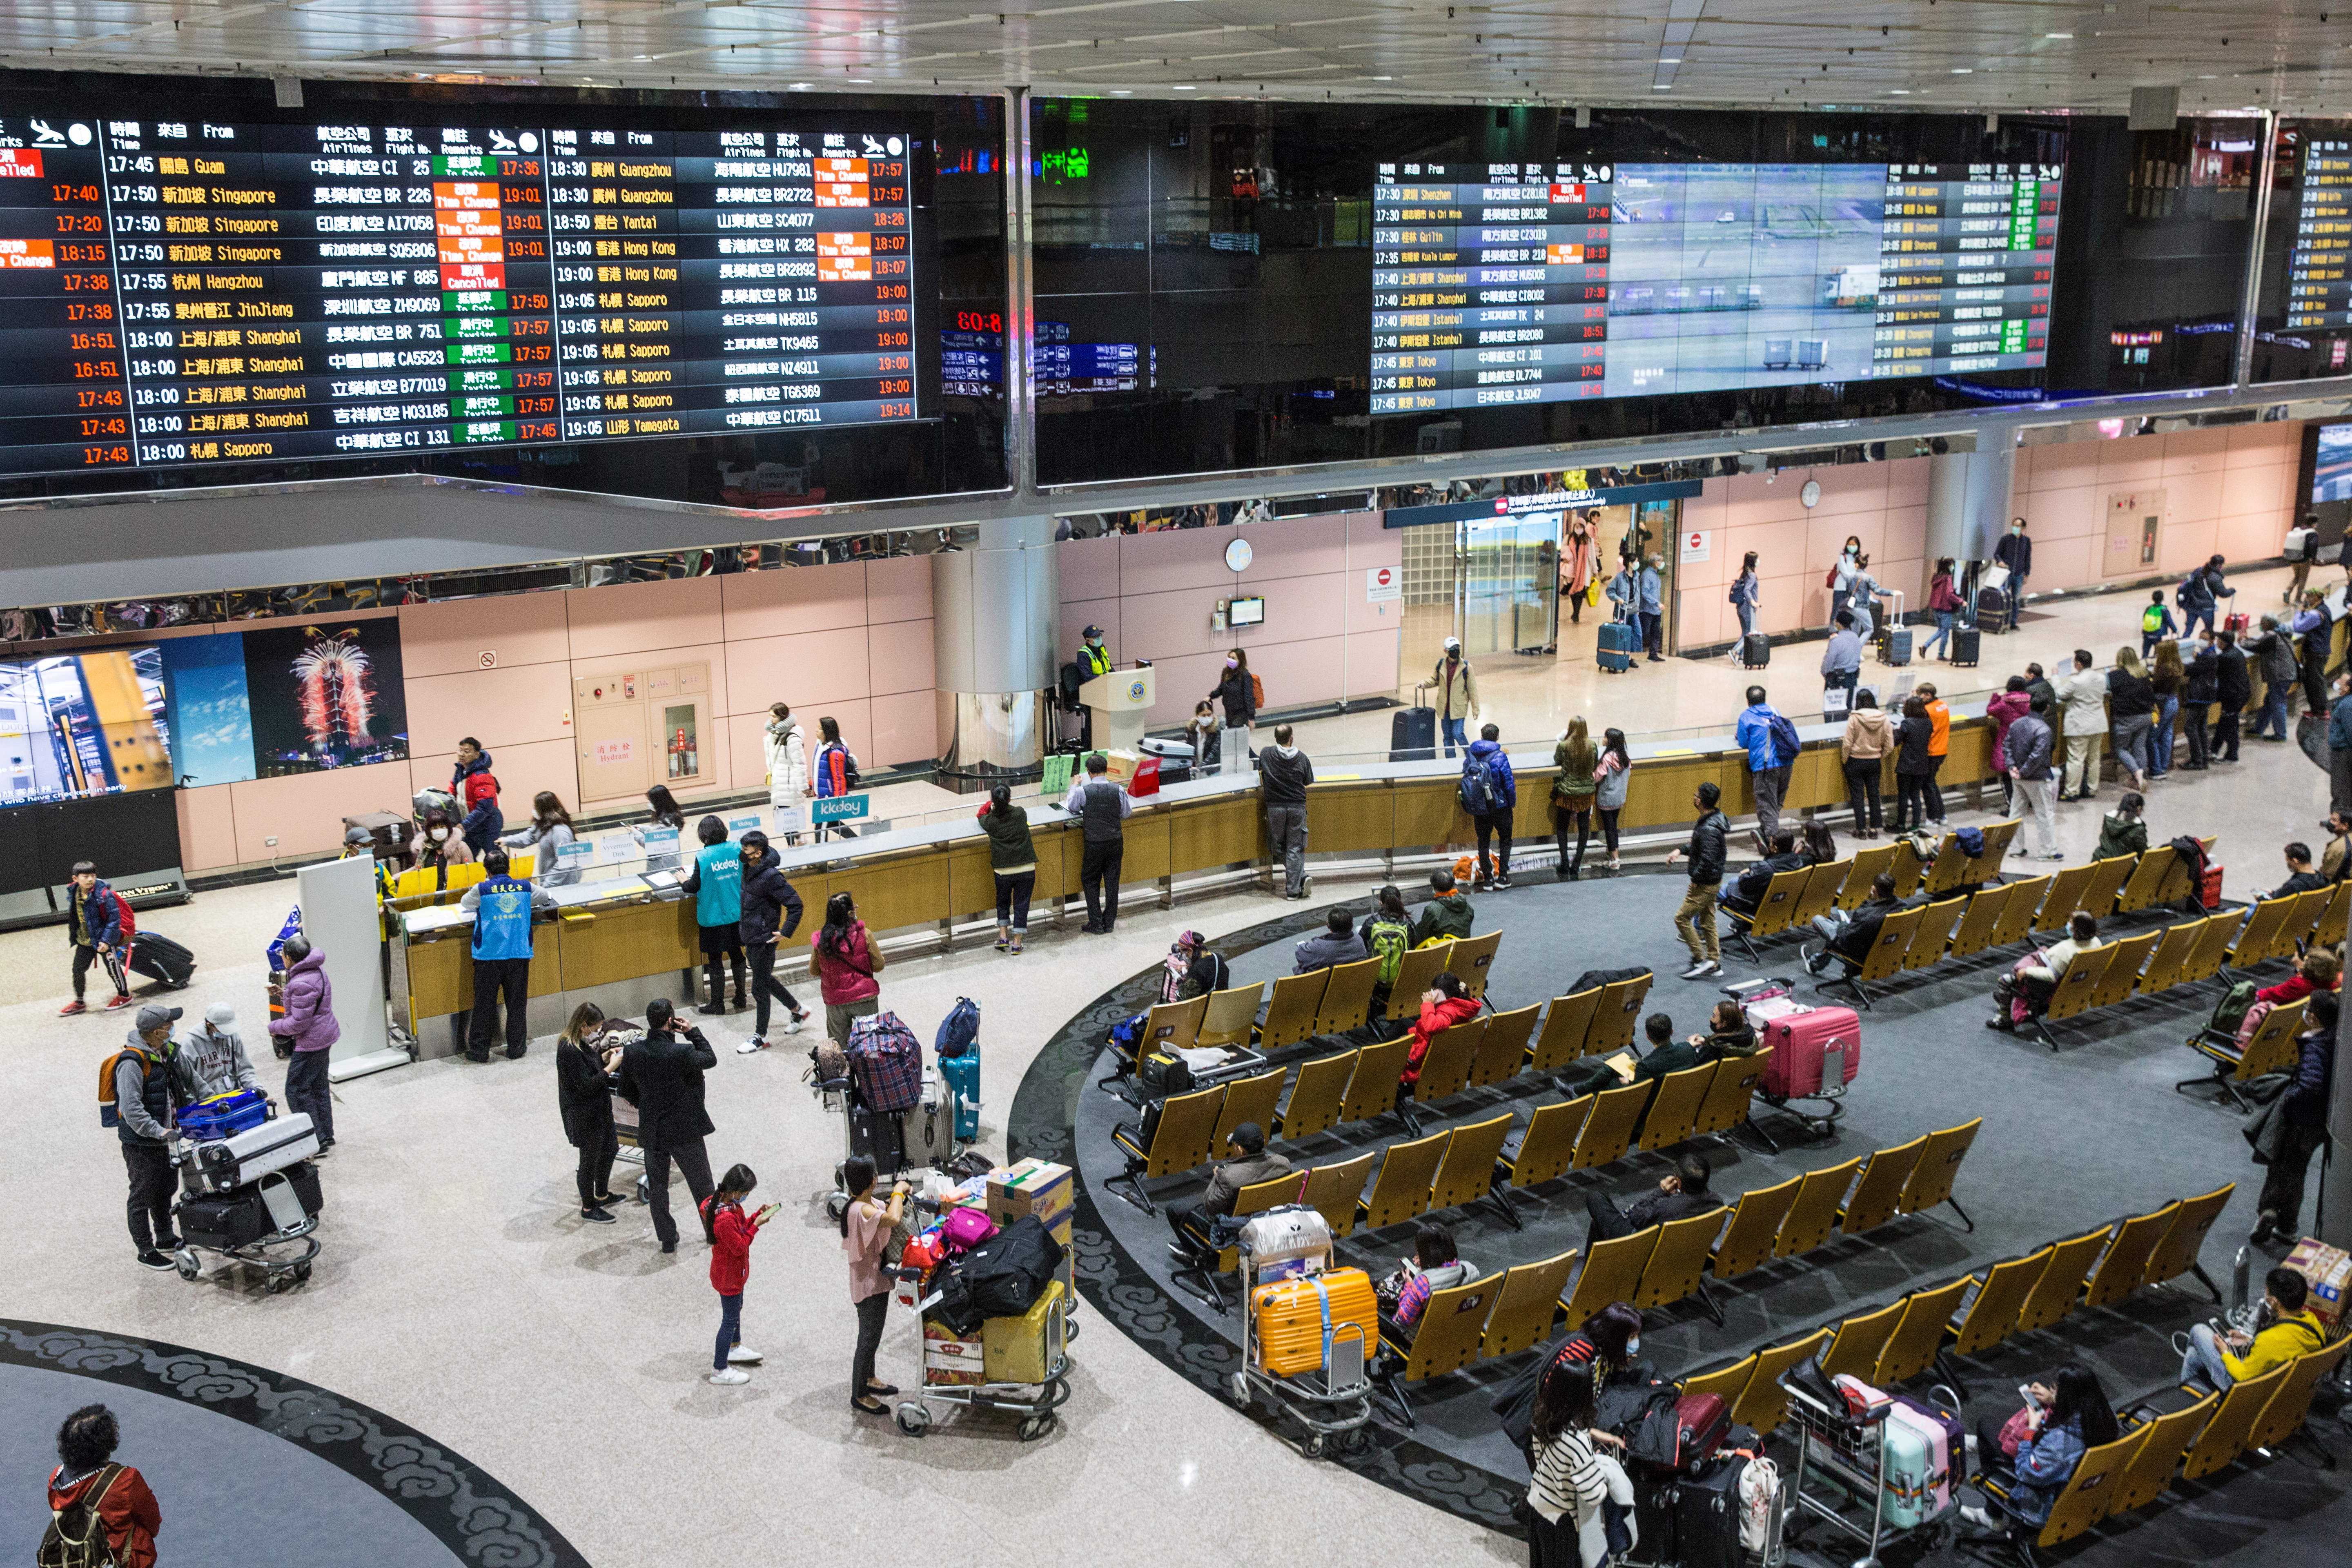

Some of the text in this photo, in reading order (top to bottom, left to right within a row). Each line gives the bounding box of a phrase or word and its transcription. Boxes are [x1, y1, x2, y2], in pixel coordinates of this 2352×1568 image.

[110, 121, 468, 142] 時間 來自 From 航空公司 班次 備註
[111, 138, 483, 155] Time Airlines Flight No. Remarks
[109, 156, 539, 175] 17:45 關島 Guam 中華航空 CI 25 17:36
[551, 161, 902, 178] 18:30 廣州 Guangzhou 海南航空 HU7981 17:57
[1380, 163, 1395, 174] 時間
[1405, 164, 1420, 174] 來自
[1428, 164, 1444, 174] From
[1380, 176, 1394, 184] Time
[53, 185, 98, 201] 17:40
[112, 186, 541, 204] 17:50 新加坡 Singapore 長榮航空 BR 226 19:01
[1376, 187, 1548, 200] 17:30 深圳 Shenzhen 南方航空 CZ8161
[1553, 192, 1582, 203] Cancelled
[436, 195, 499, 208] Time Change
[554, 212, 904, 229] 18:50 煙台 Yantai 山東航空 SC4077 18:26
[1376, 209, 1399, 221] 17:30
[1437, 210, 1446, 218] Chi
[1483, 208, 1520, 220] 長榮航空
[1588, 207, 1608, 218] 17:40
[60, 245, 105, 261] 18:15
[556, 236, 905, 256] 19:00 香港 Hong Kong 香港航空 HX 282 18:07
[10, 254, 53, 267] Change
[123, 274, 166, 290] 17:55
[172, 274, 200, 290] 杭州
[206, 274, 263, 290] Hangzhou
[391, 270, 407, 285] MF
[414, 270, 438, 284] 885
[448, 277, 499, 289] Cancelled
[126, 294, 548, 319] 17:55 泉州晉江 JinJiang 深圳航空 ZH9069 17:50
[1374, 315, 1397, 327] 17:40
[1433, 313, 1463, 325] Istanbul
[1518, 310, 1527, 321] TK
[1535, 309, 1544, 320] 24
[71, 333, 116, 349] 16:51
[129, 332, 172, 347] 18:00
[179, 330, 242, 347] 上海/浦東
[247, 329, 301, 345] Shanghai
[327, 325, 394, 342] 長榮航空
[396, 325, 412, 339] BR
[418, 324, 442, 338] 751
[514, 321, 549, 335] 17:57
[1373, 397, 1395, 410] 17:45
[1399, 397, 1412, 408] 東京
[1417, 397, 1435, 407] Tokyo
[1478, 390, 1514, 403] 日本航空
[1515, 388, 1541, 400] JL5047
[568, 403, 910, 436] 19:05 山形 Yamagata 中華航空 CI7511 19:14
[85, 447, 128, 463] 17:43
[1507, 505, 1532, 514] Controlled
[1570, 498, 1594, 509] personnel
[1594, 497, 1606, 506] only)
[597, 742, 630, 754] 消防栓
[601, 753, 629, 762] Hydrant
[27, 794, 50, 802] have
[52, 788, 91, 799] checked
[105, 784, 127, 792] early
[821, 801, 860, 815] kkday
[603, 842, 633, 852] Vyvermans
[711, 859, 739, 872] kkday
